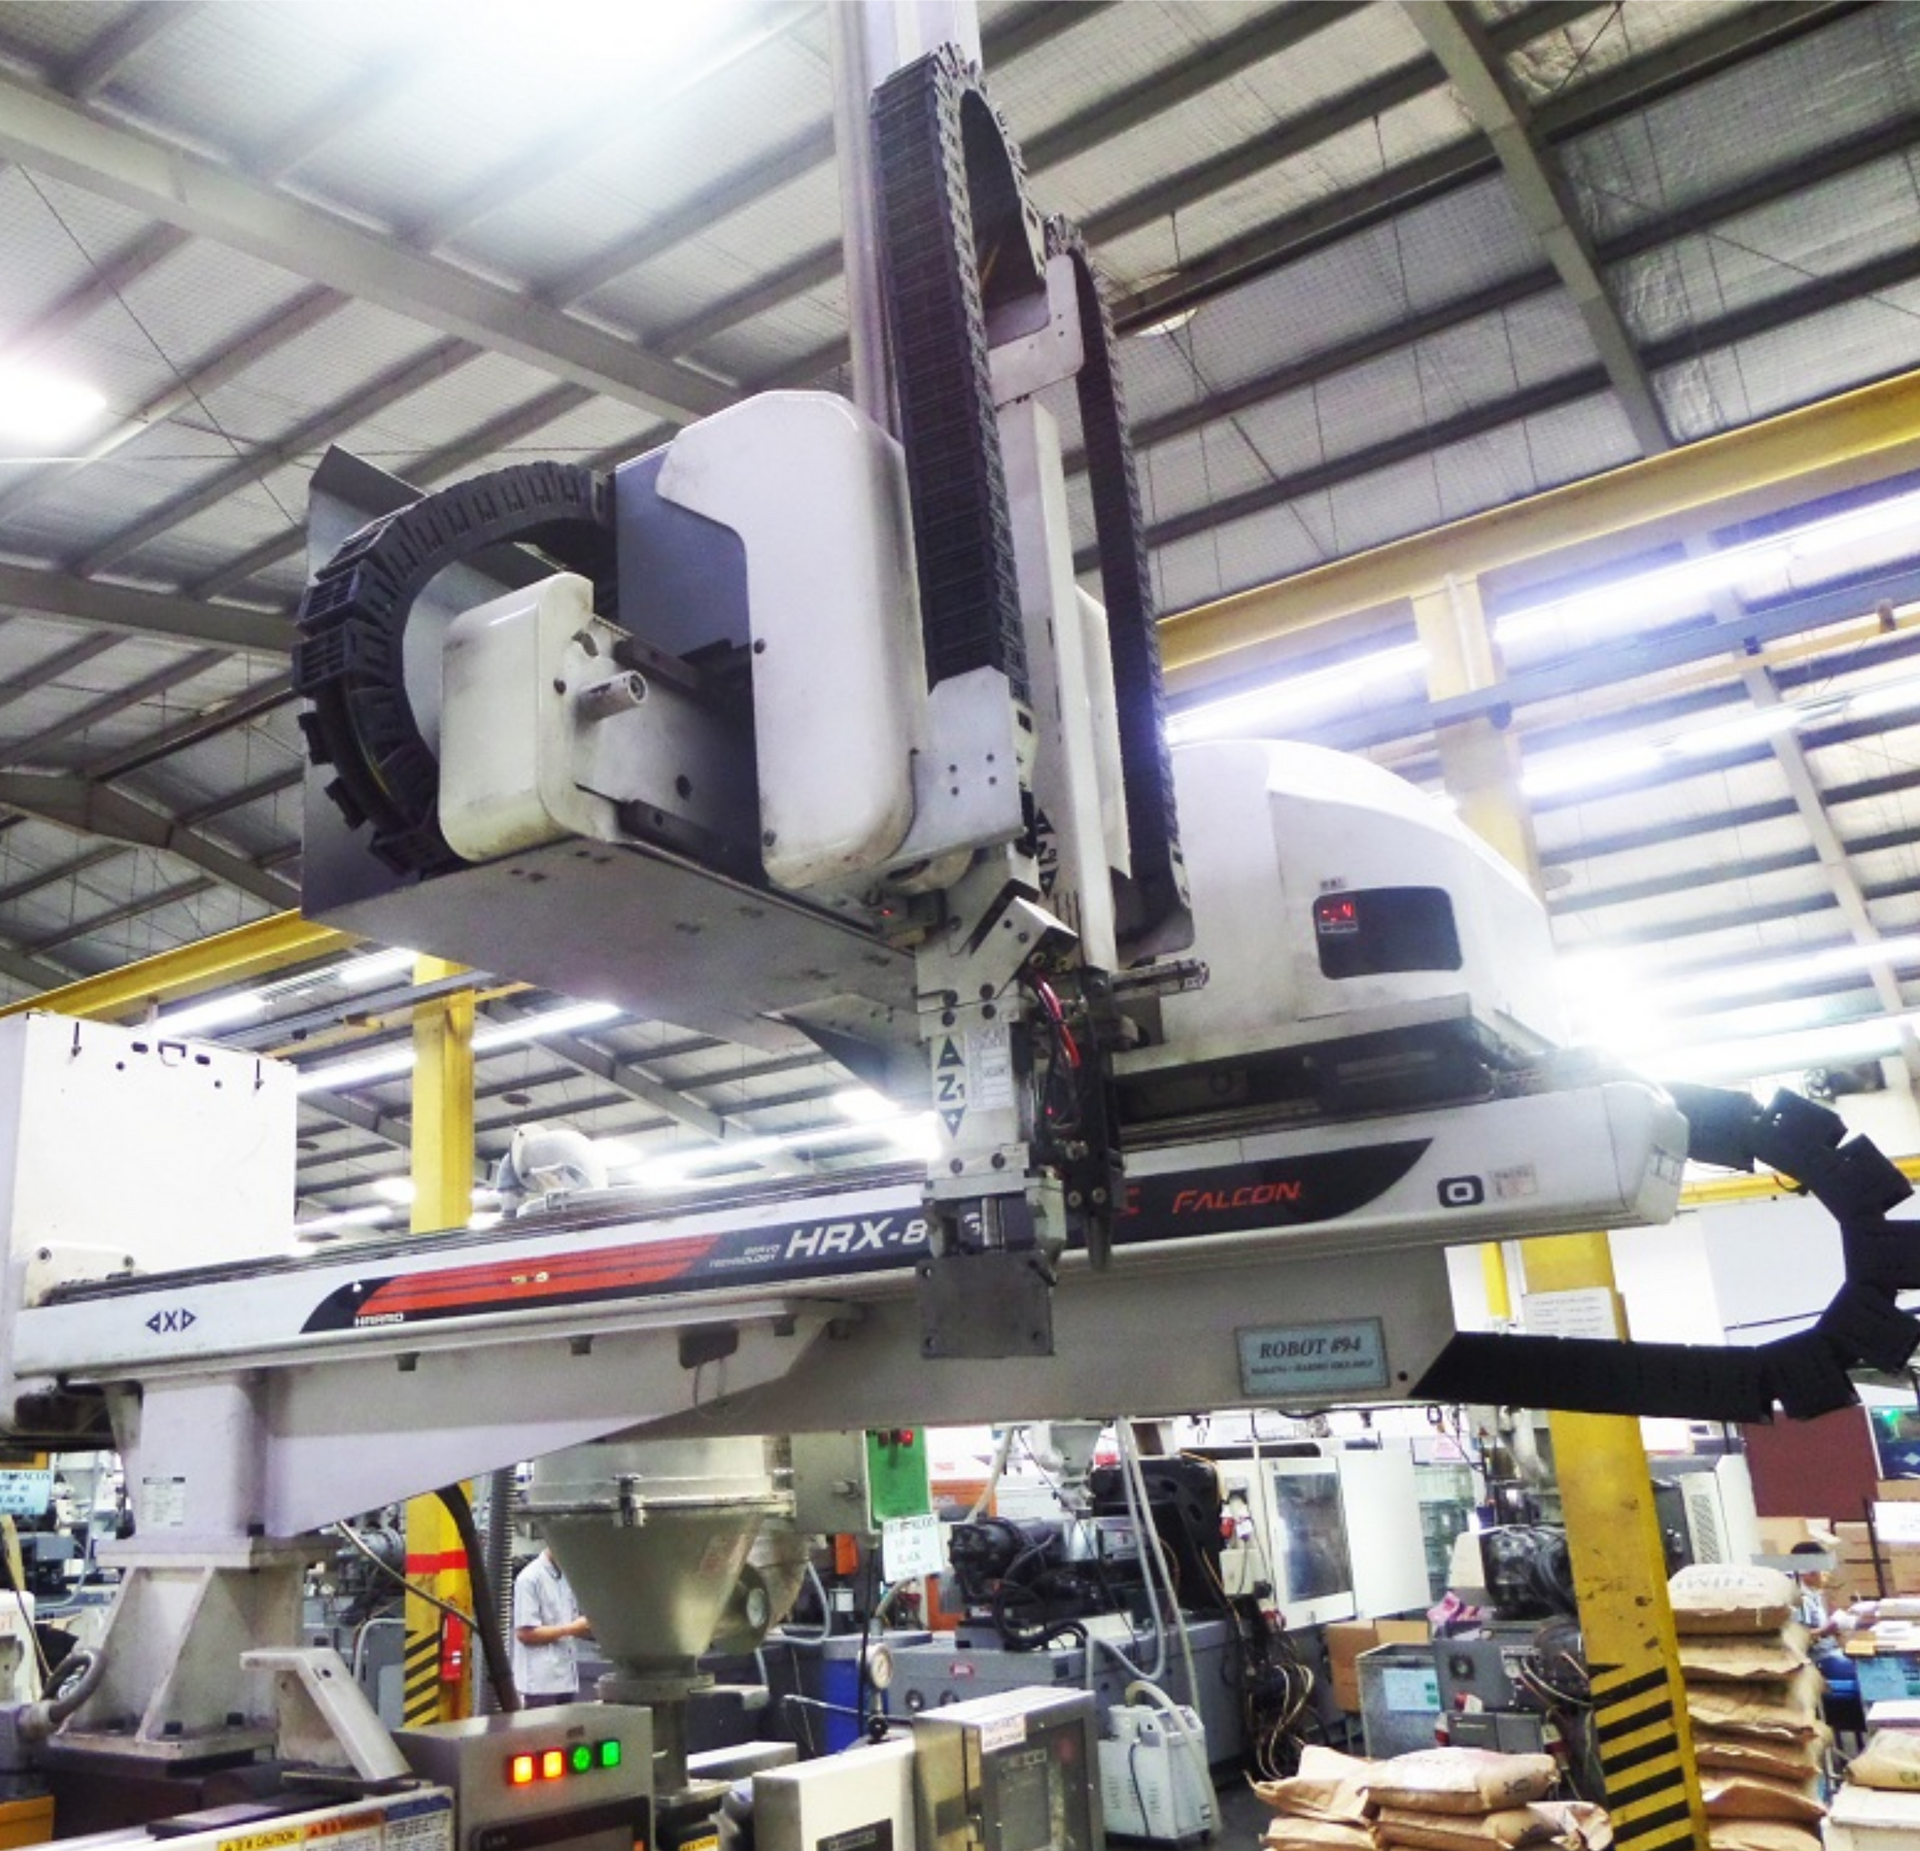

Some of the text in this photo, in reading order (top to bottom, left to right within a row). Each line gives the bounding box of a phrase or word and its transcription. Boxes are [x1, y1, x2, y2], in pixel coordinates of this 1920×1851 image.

[937, 1074, 966, 1101] Z1
[1172, 1180, 1301, 1214] FALCON
[1259, 1338, 1327, 1359] ROBOT
